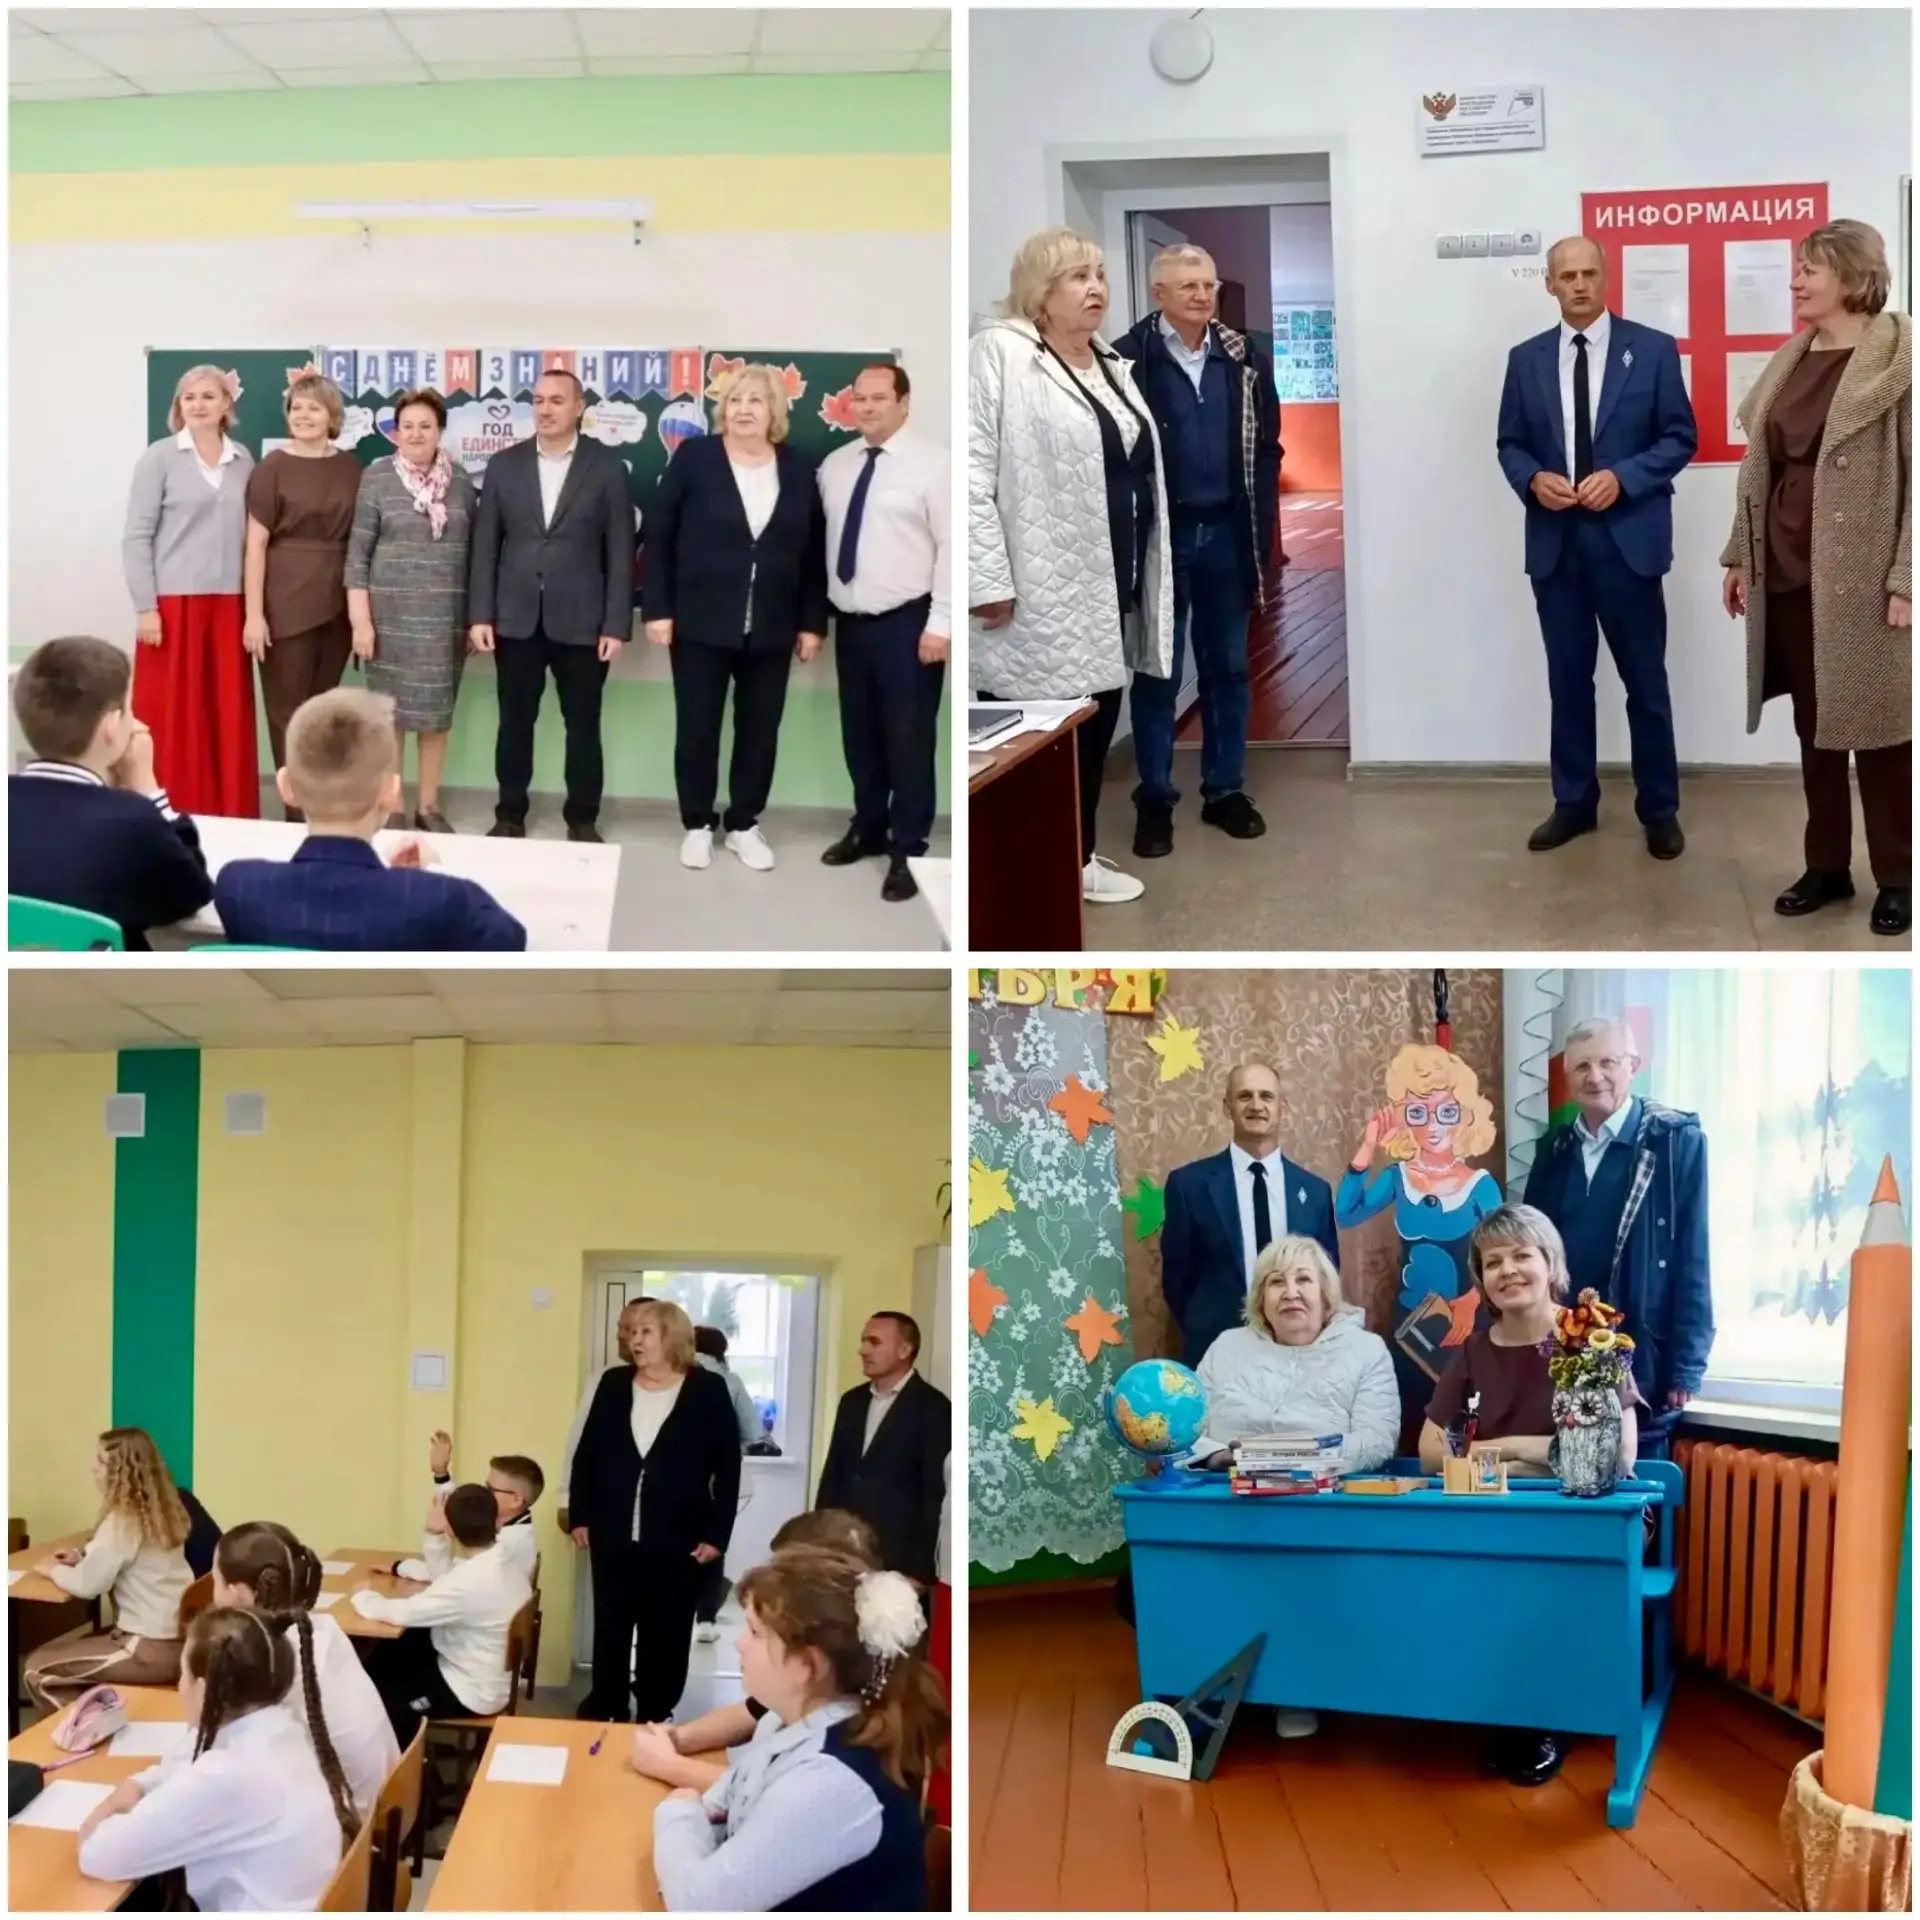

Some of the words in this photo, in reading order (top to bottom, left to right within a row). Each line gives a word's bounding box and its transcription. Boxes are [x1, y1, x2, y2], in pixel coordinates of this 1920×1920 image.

[1595, 197, 1815, 229] ИНФОРМАЦИЯ
[331, 355, 346, 382] С
[363, 352, 470, 385] ДНЁМ
[482, 422, 514, 437] ГОД
[461, 452, 492, 462] НАРОД
